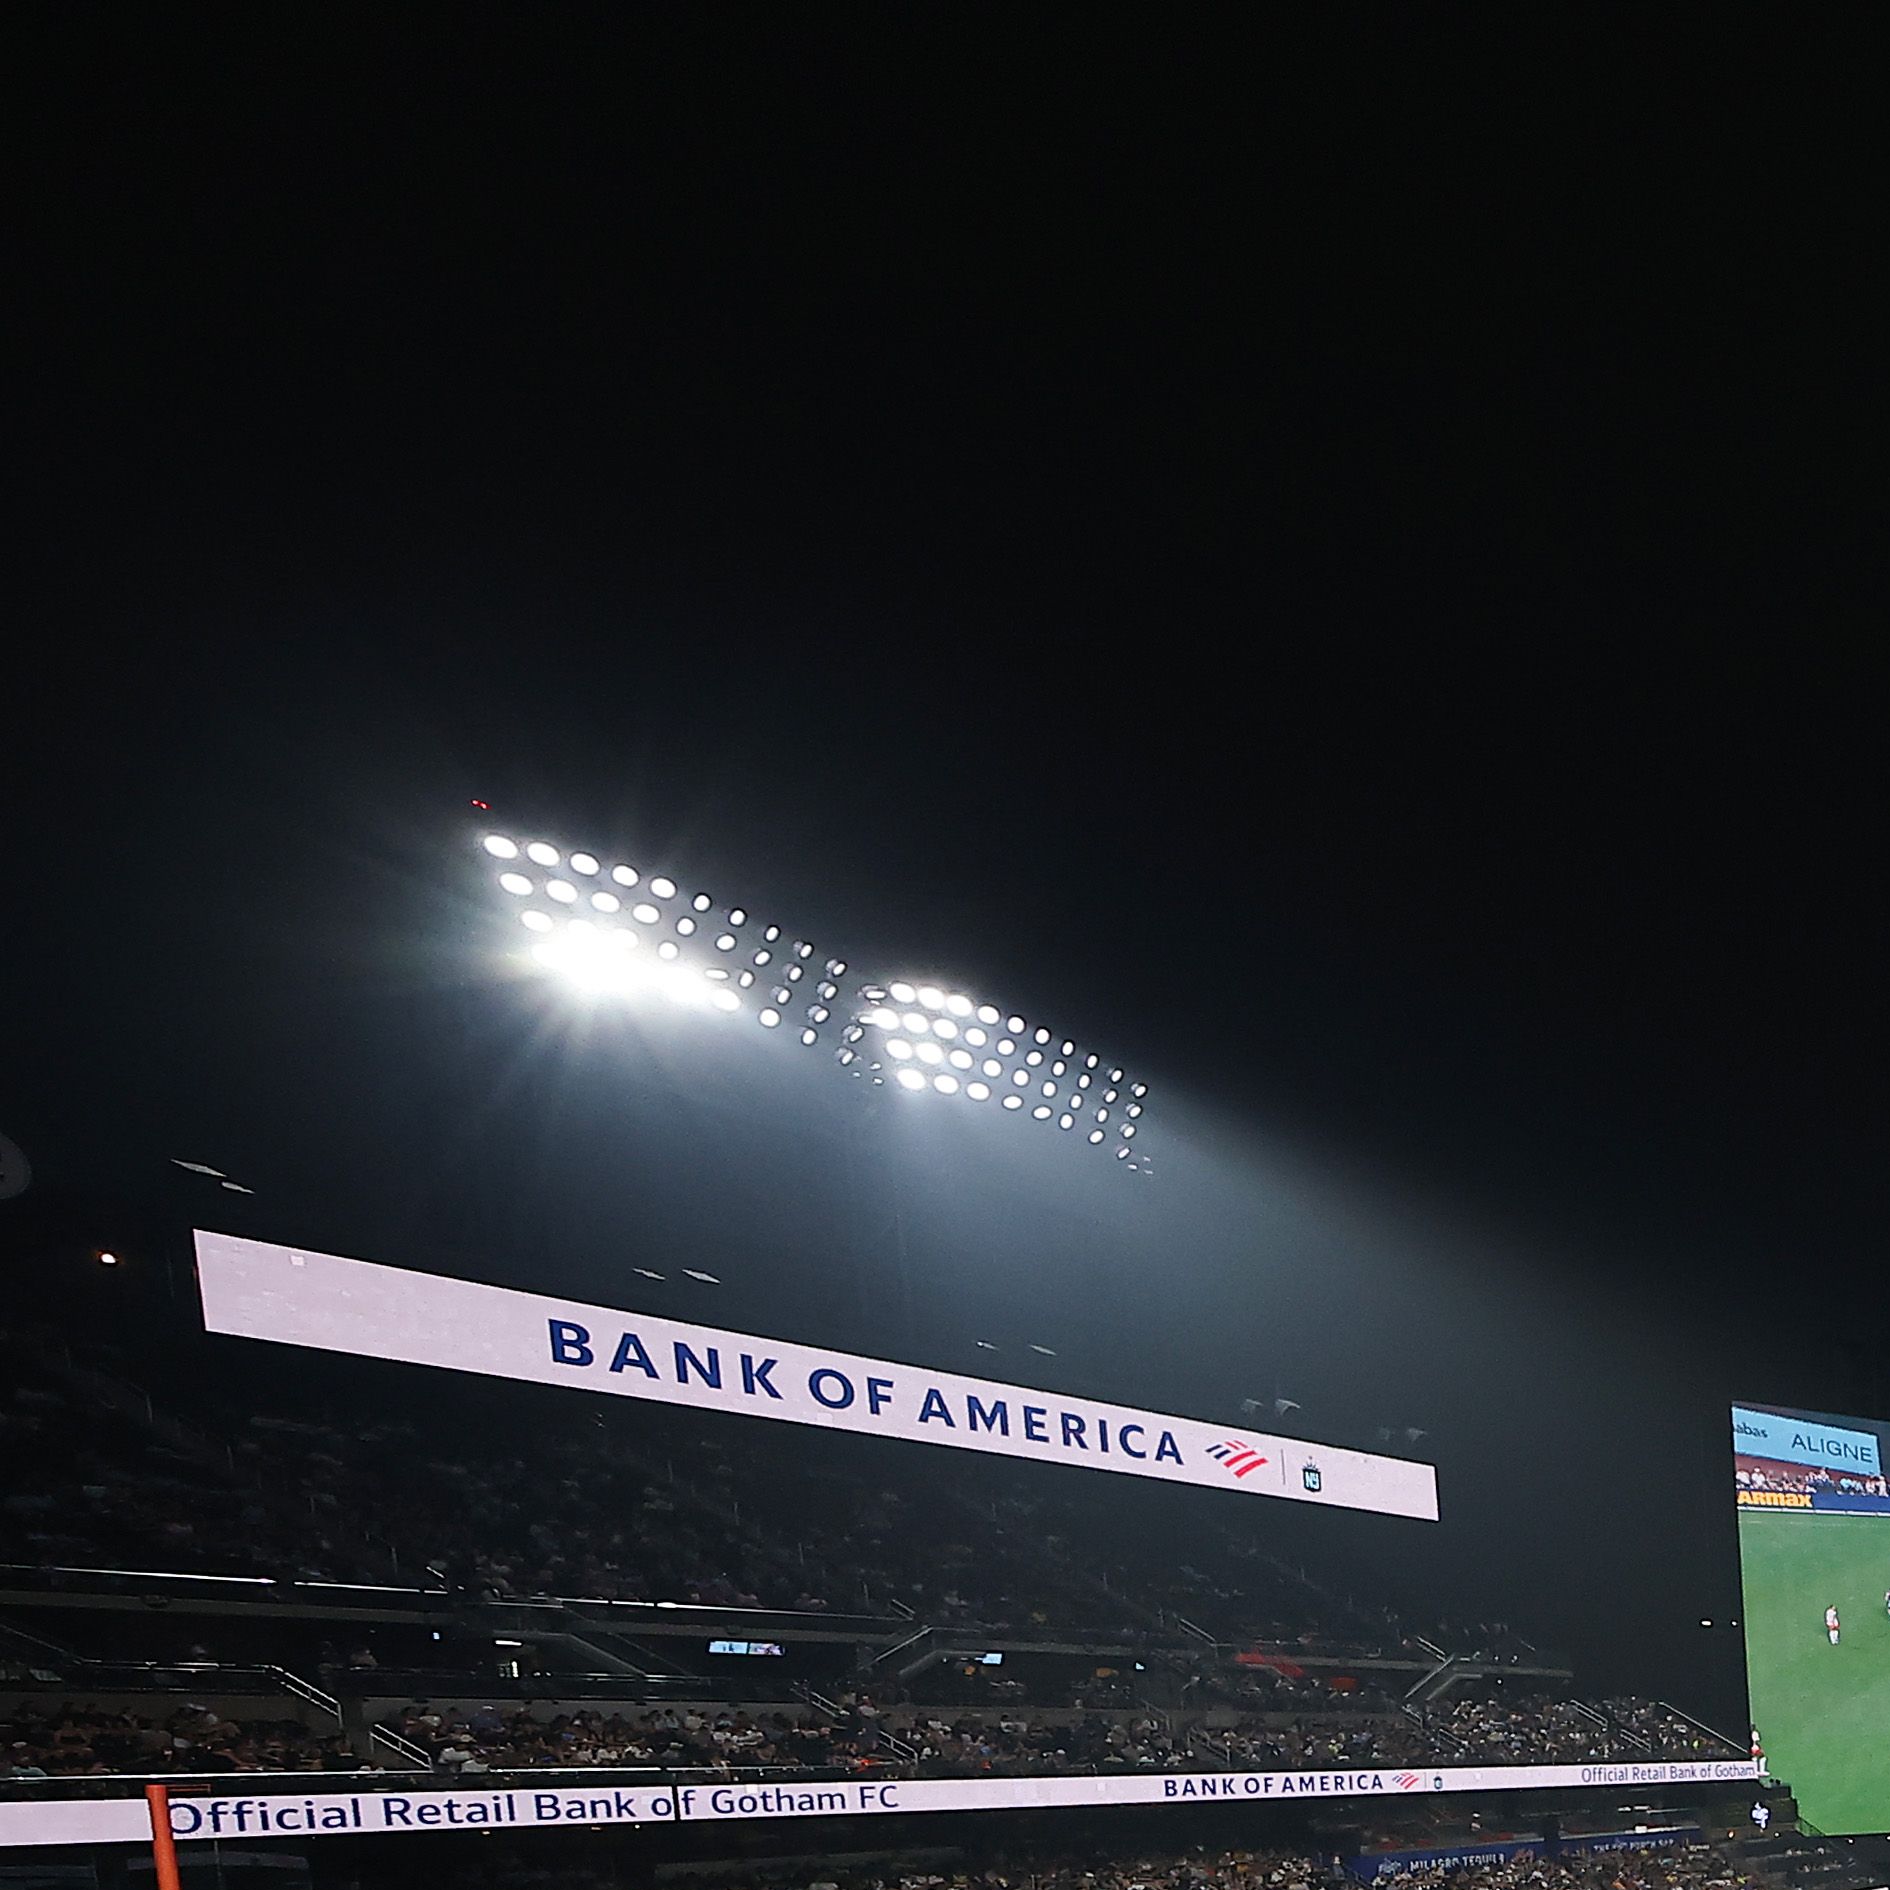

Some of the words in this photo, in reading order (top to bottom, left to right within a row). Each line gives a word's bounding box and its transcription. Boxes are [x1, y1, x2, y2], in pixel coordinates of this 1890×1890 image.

[548, 1318, 784, 1400] BANK
[808, 1367, 894, 1416] OF
[918, 1388, 1184, 1466] AMERICA
[1792, 1432, 1872, 1464] ALIGNE
[1164, 1778, 1236, 1797] BANK
[1244, 1776, 1274, 1794] OF
[1281, 1774, 1384, 1793] AMERICA
[1581, 1766, 1629, 1783] Official
[1632, 1765, 1667, 1782] Retail
[1670, 1764, 1698, 1780] Bank
[1700, 1763, 1712, 1778] of
[168, 1798, 362, 1834] Official
[382, 1793, 515, 1827] Retail
[534, 1790, 637, 1821] Bank
[651, 1789, 696, 1817] of
[711, 1787, 846, 1815] Gotham
[859, 1785, 900, 1809] FC
